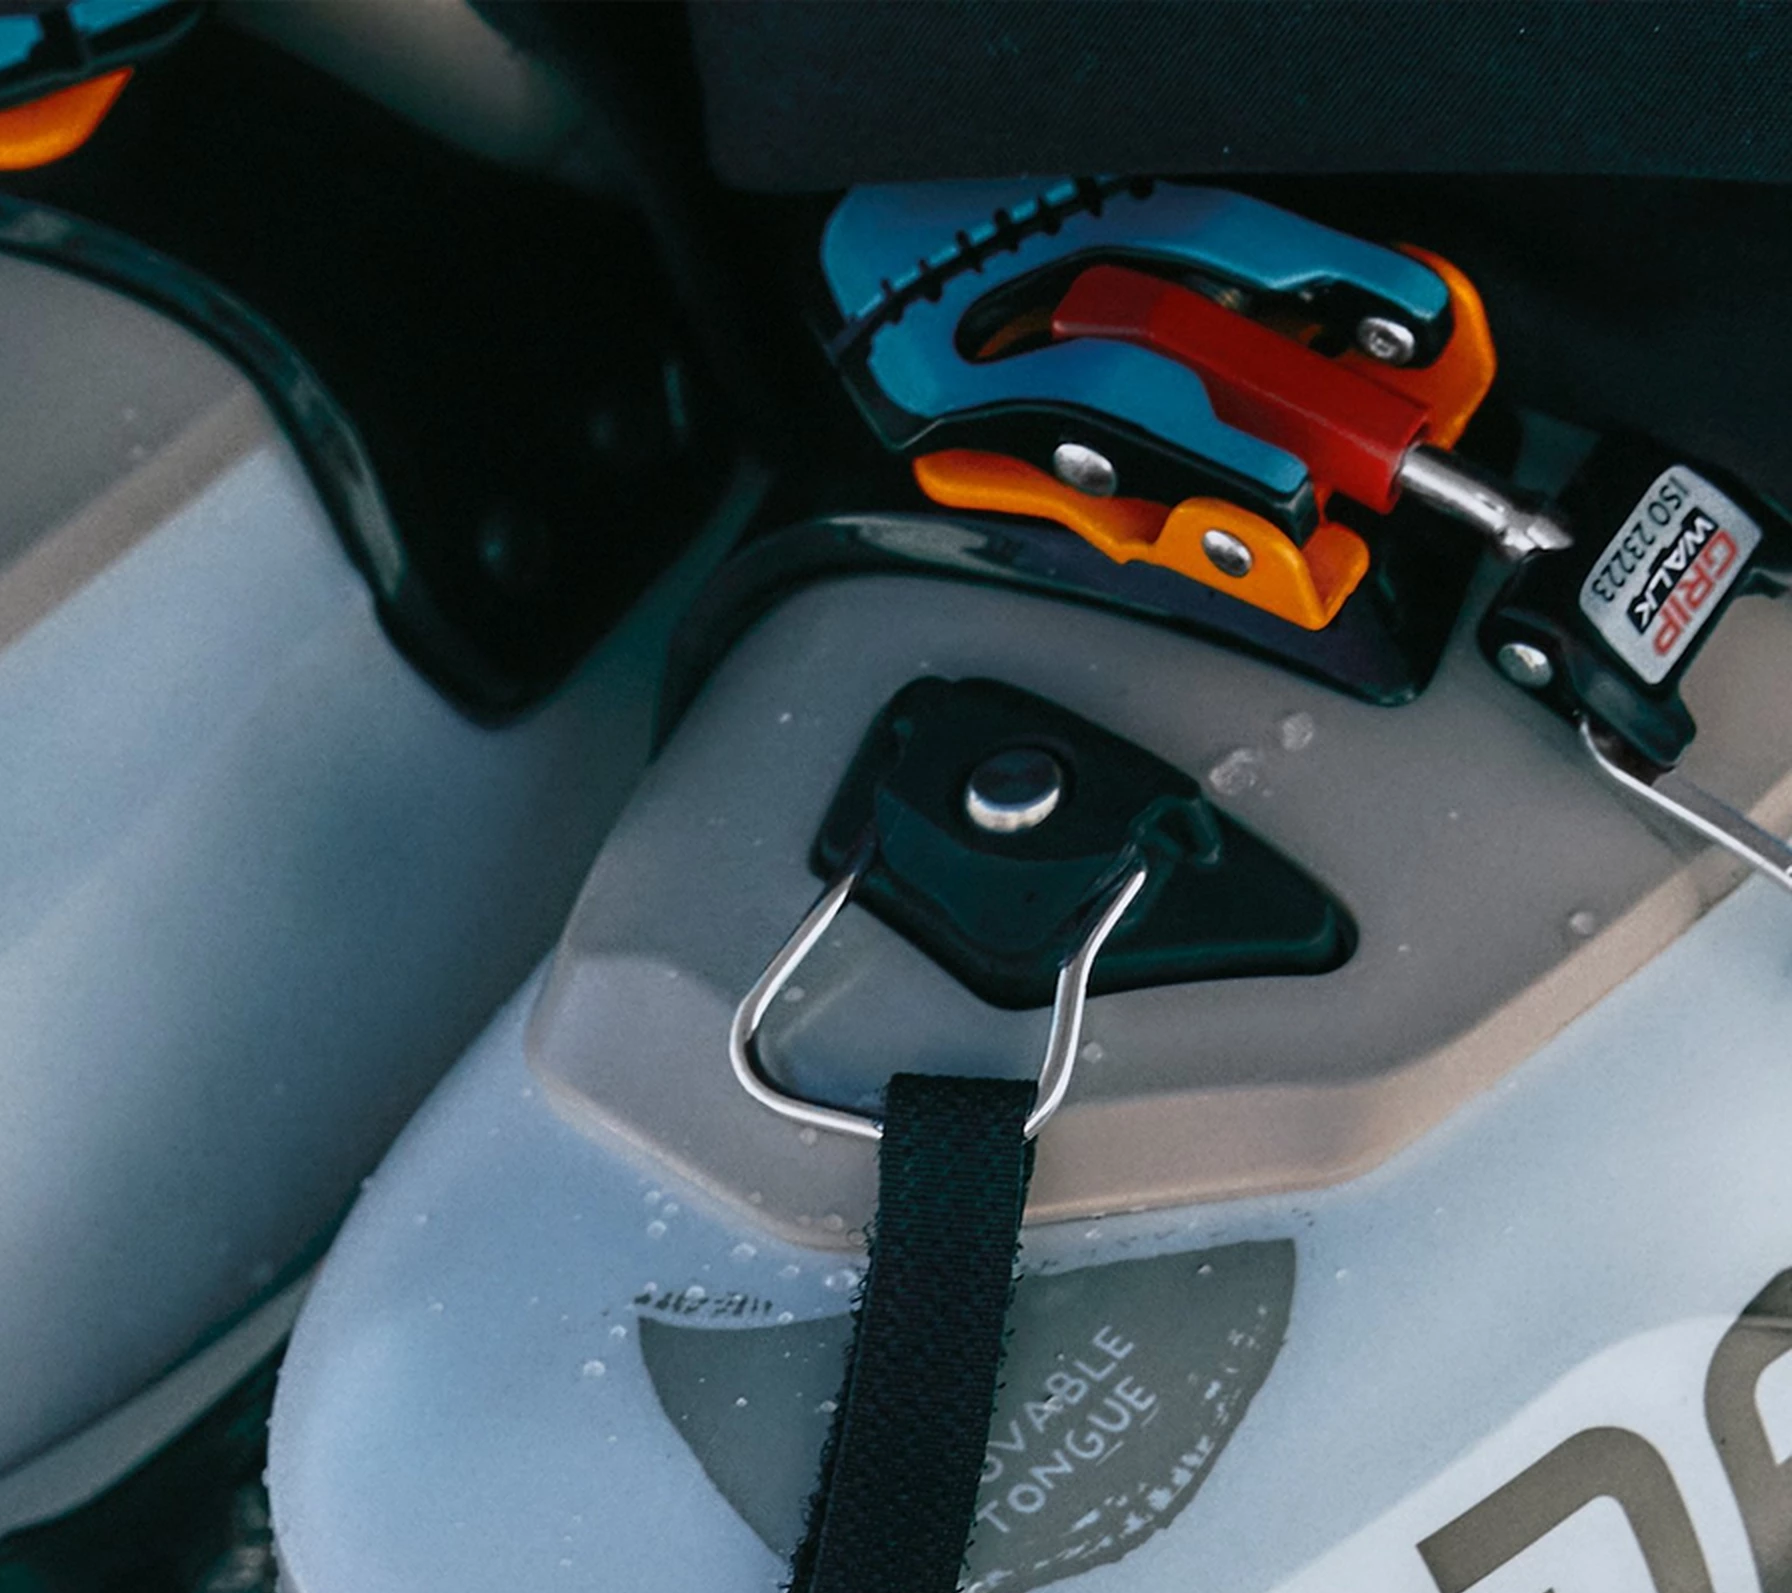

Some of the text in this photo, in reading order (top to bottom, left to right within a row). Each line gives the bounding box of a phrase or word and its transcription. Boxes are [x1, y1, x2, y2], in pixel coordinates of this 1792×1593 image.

[1591, 476, 1690, 603] ISO 23223
[1633, 516, 1714, 628] WALK
[1653, 528, 1738, 656] GRIP
[975, 1375, 1157, 1533] TONGUE
[979, 1325, 1134, 1483] OVABLE
